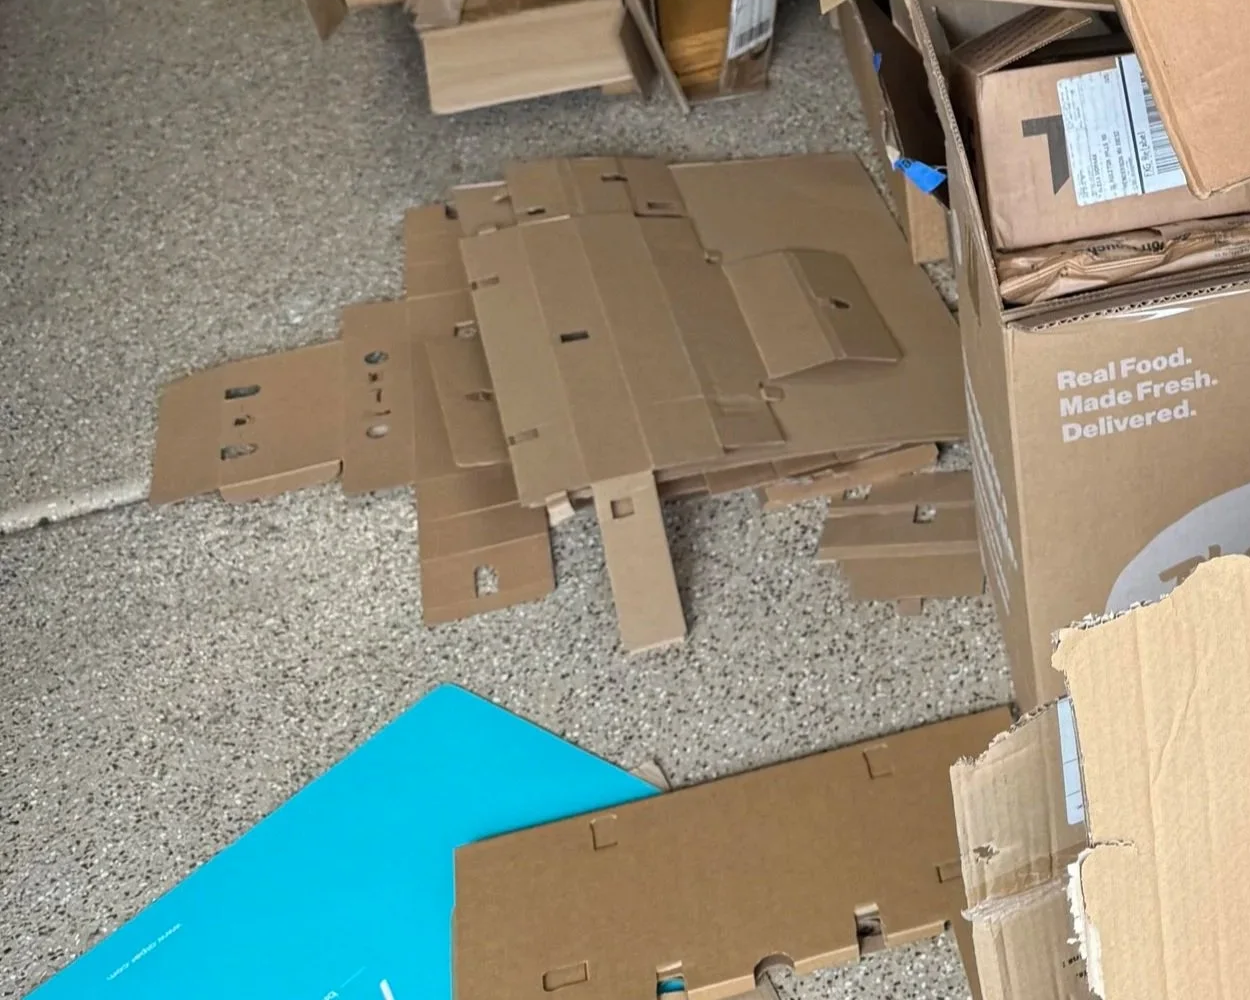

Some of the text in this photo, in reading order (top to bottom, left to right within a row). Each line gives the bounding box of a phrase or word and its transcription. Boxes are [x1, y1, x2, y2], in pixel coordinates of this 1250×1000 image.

[1056, 347, 1192, 391] Real Food.
[1059, 369, 1218, 417] Made Fresh.
[1061, 399, 1197, 443] Delivered.
